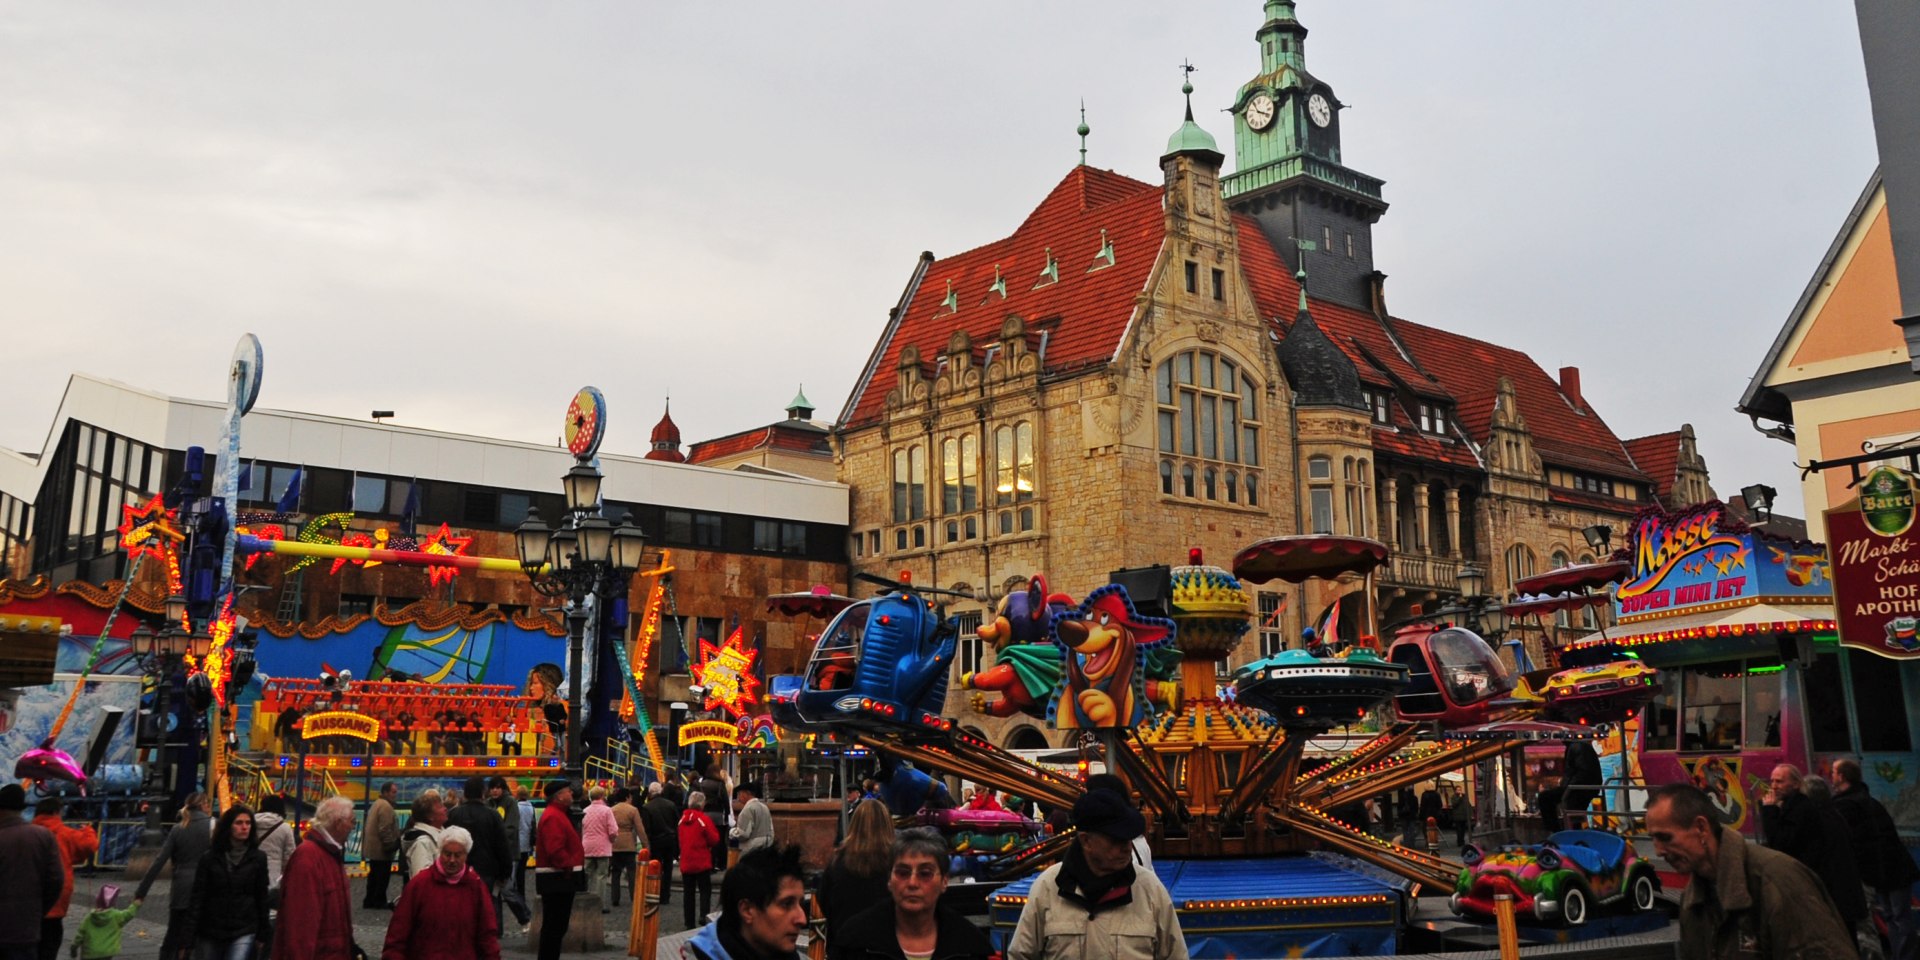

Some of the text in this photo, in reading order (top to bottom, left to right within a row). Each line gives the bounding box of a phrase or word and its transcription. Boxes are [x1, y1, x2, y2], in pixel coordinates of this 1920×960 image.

[1862, 494, 1912, 511] Barre
[1635, 510, 1720, 577] Kasse
[1839, 537, 1918, 566] Markt-
[1621, 576, 1747, 614] SUPER MINI JET
[1879, 584, 1919, 599] HOF
[1855, 599, 1920, 617] APOTH
[310, 717, 372, 734] AUSGANG
